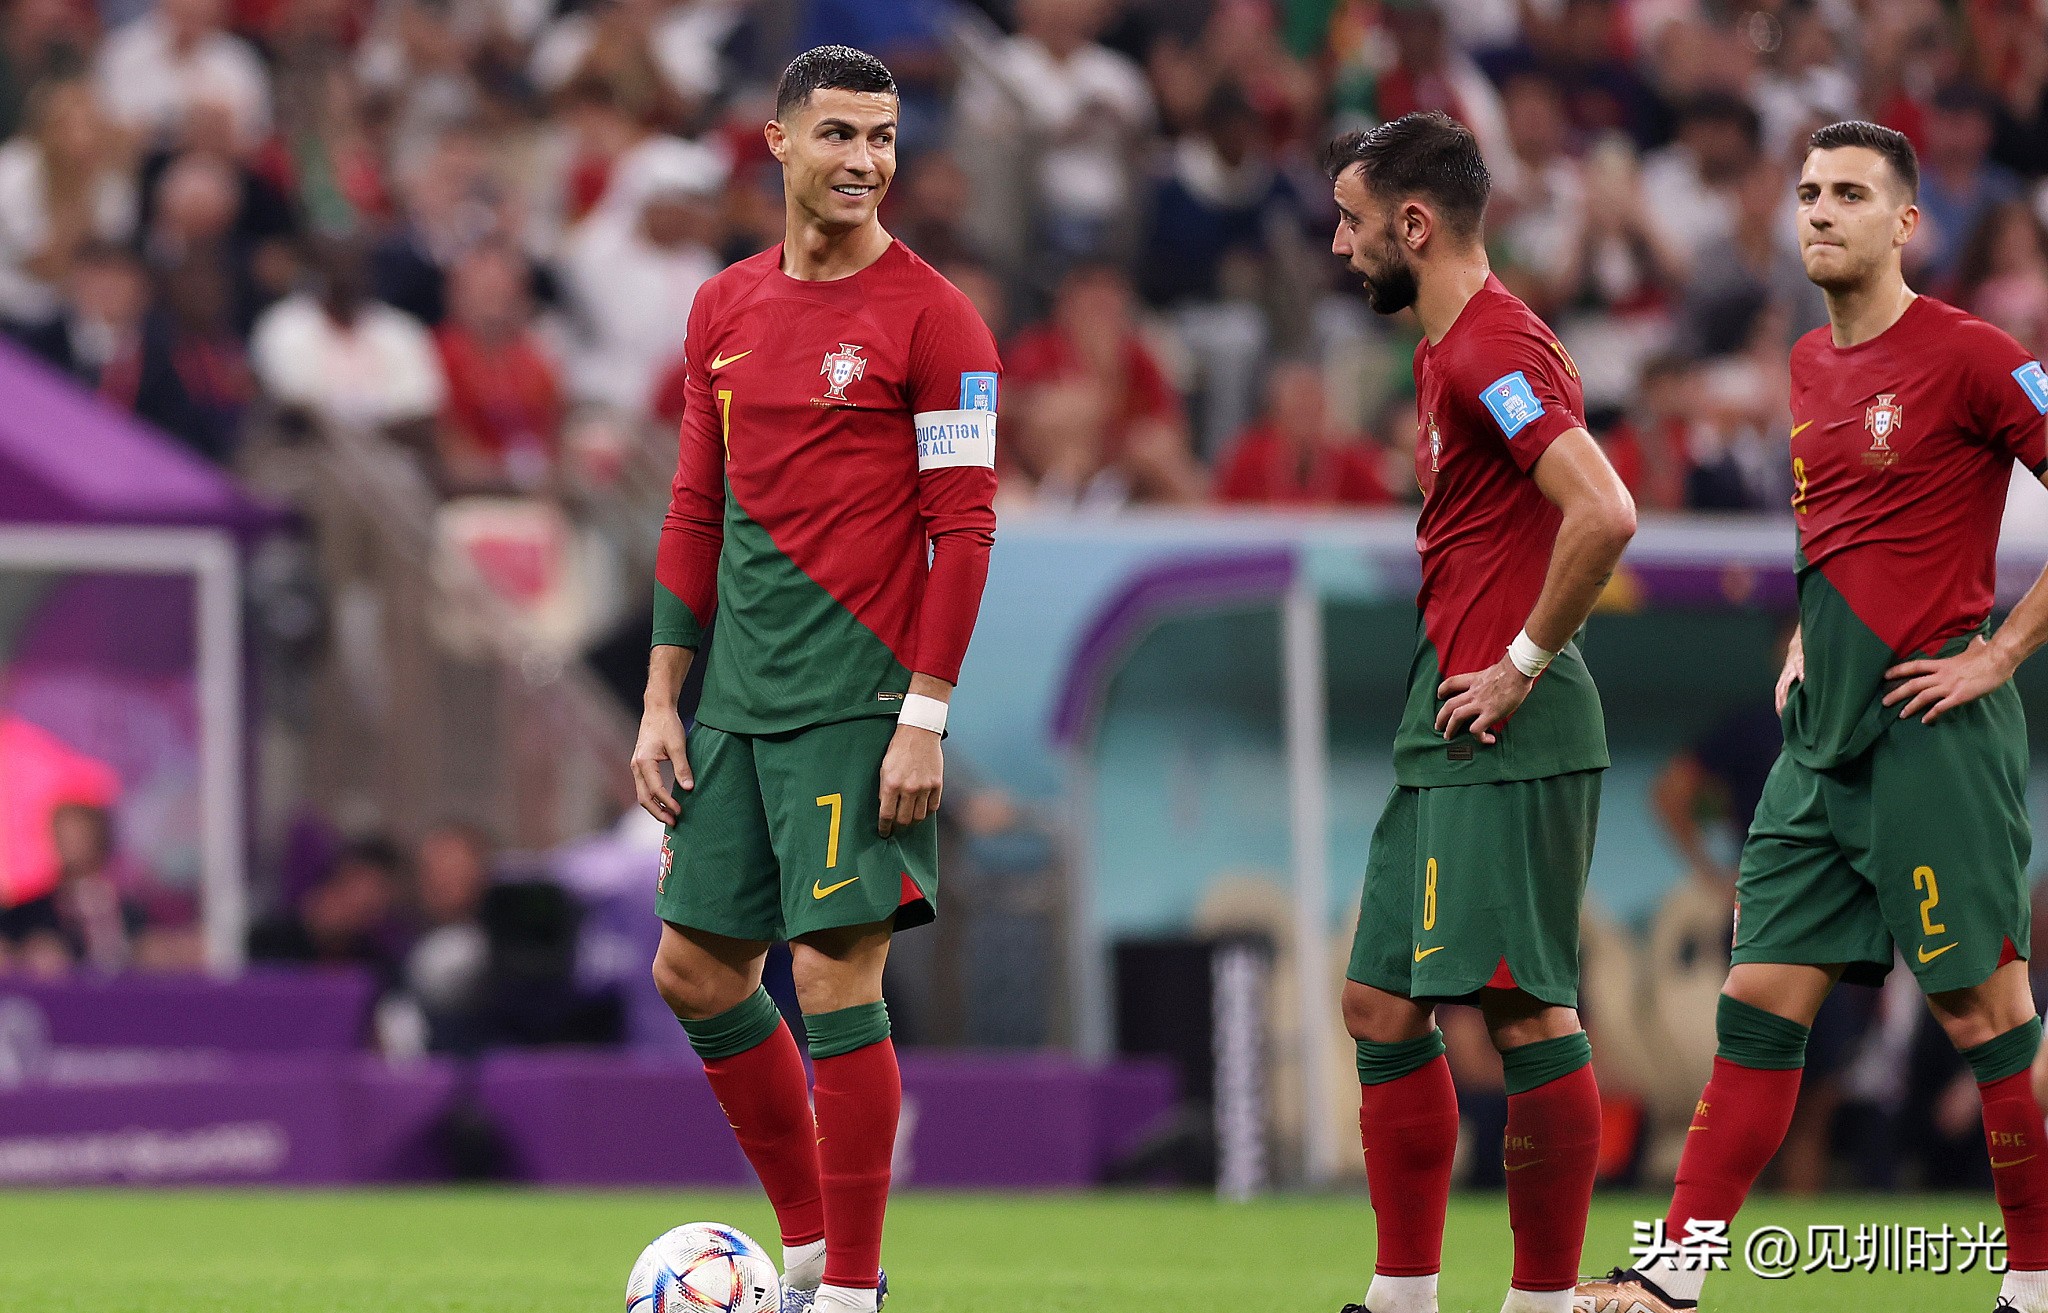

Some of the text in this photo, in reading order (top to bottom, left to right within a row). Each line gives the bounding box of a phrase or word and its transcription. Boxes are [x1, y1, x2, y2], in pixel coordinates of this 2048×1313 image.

[718, 390, 732, 461] 7
[916, 424, 980, 443] DUCATION
[917, 440, 956, 458] OR ALL
[816, 792, 842, 868] 7
[1423, 857, 1439, 930] 8
[1912, 865, 1947, 935] 2
